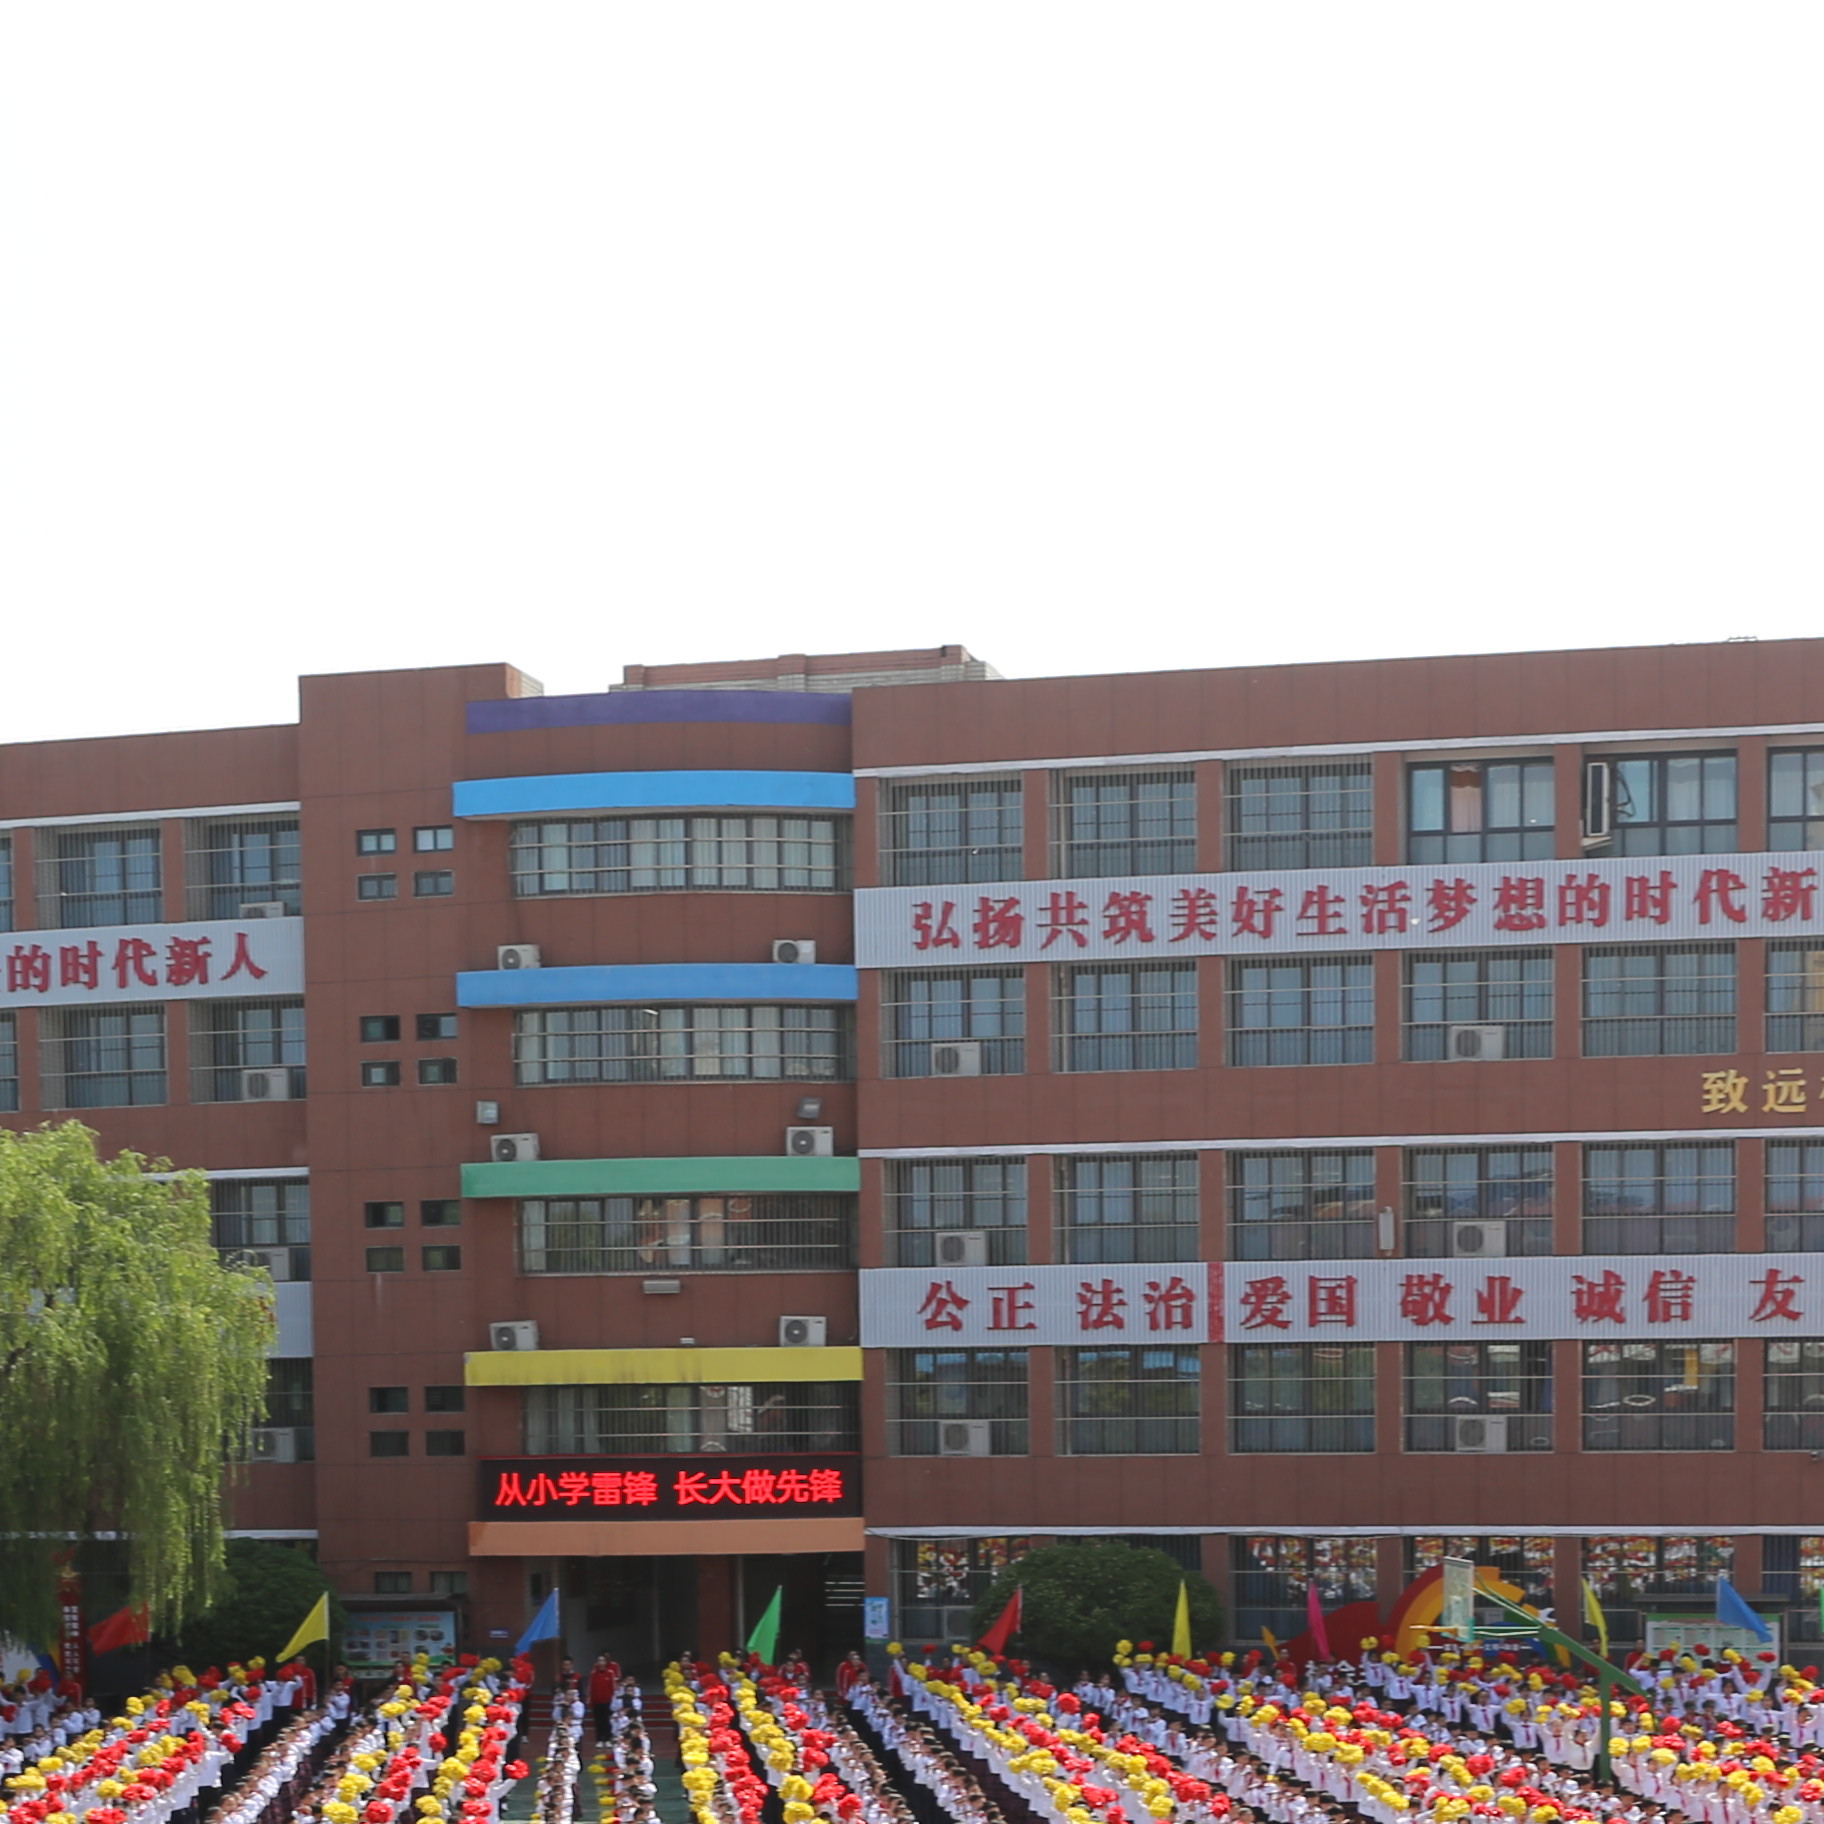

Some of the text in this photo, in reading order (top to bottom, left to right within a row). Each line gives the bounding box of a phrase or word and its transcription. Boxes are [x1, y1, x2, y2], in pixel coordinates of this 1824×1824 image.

[917, 1280, 1039, 1332] 公正
[1075, 1277, 1197, 1331] 法治
[1239, 1274, 1358, 1329] 爱国
[1398, 1273, 1526, 1326] 敬业
[1570, 1269, 1697, 1324] 诚信
[494, 1468, 843, 1507] 从小学雷锋 长大做先锋
